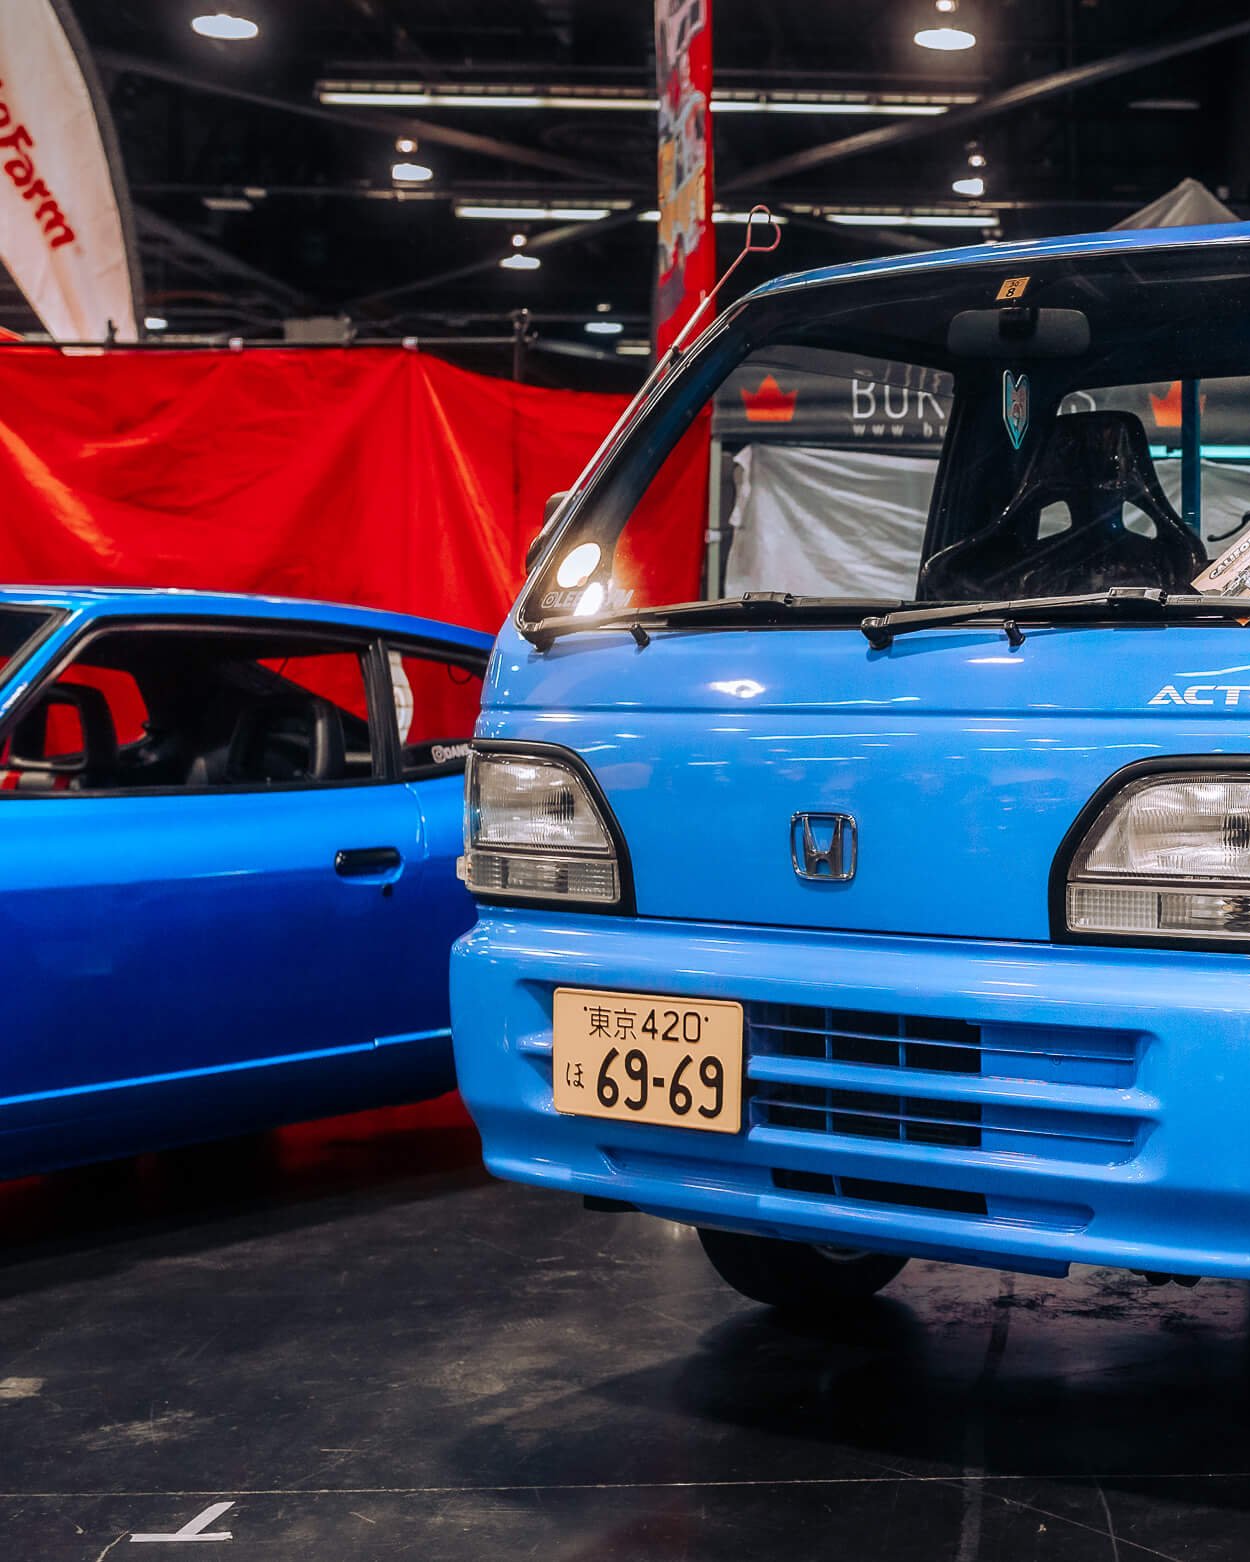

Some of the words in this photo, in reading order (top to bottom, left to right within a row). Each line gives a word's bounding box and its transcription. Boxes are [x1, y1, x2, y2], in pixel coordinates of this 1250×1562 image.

[1006, 288, 1016, 297] 8
[566, 1061, 585, 1089] ほ
[597, 1047, 724, 1118] 69-69
